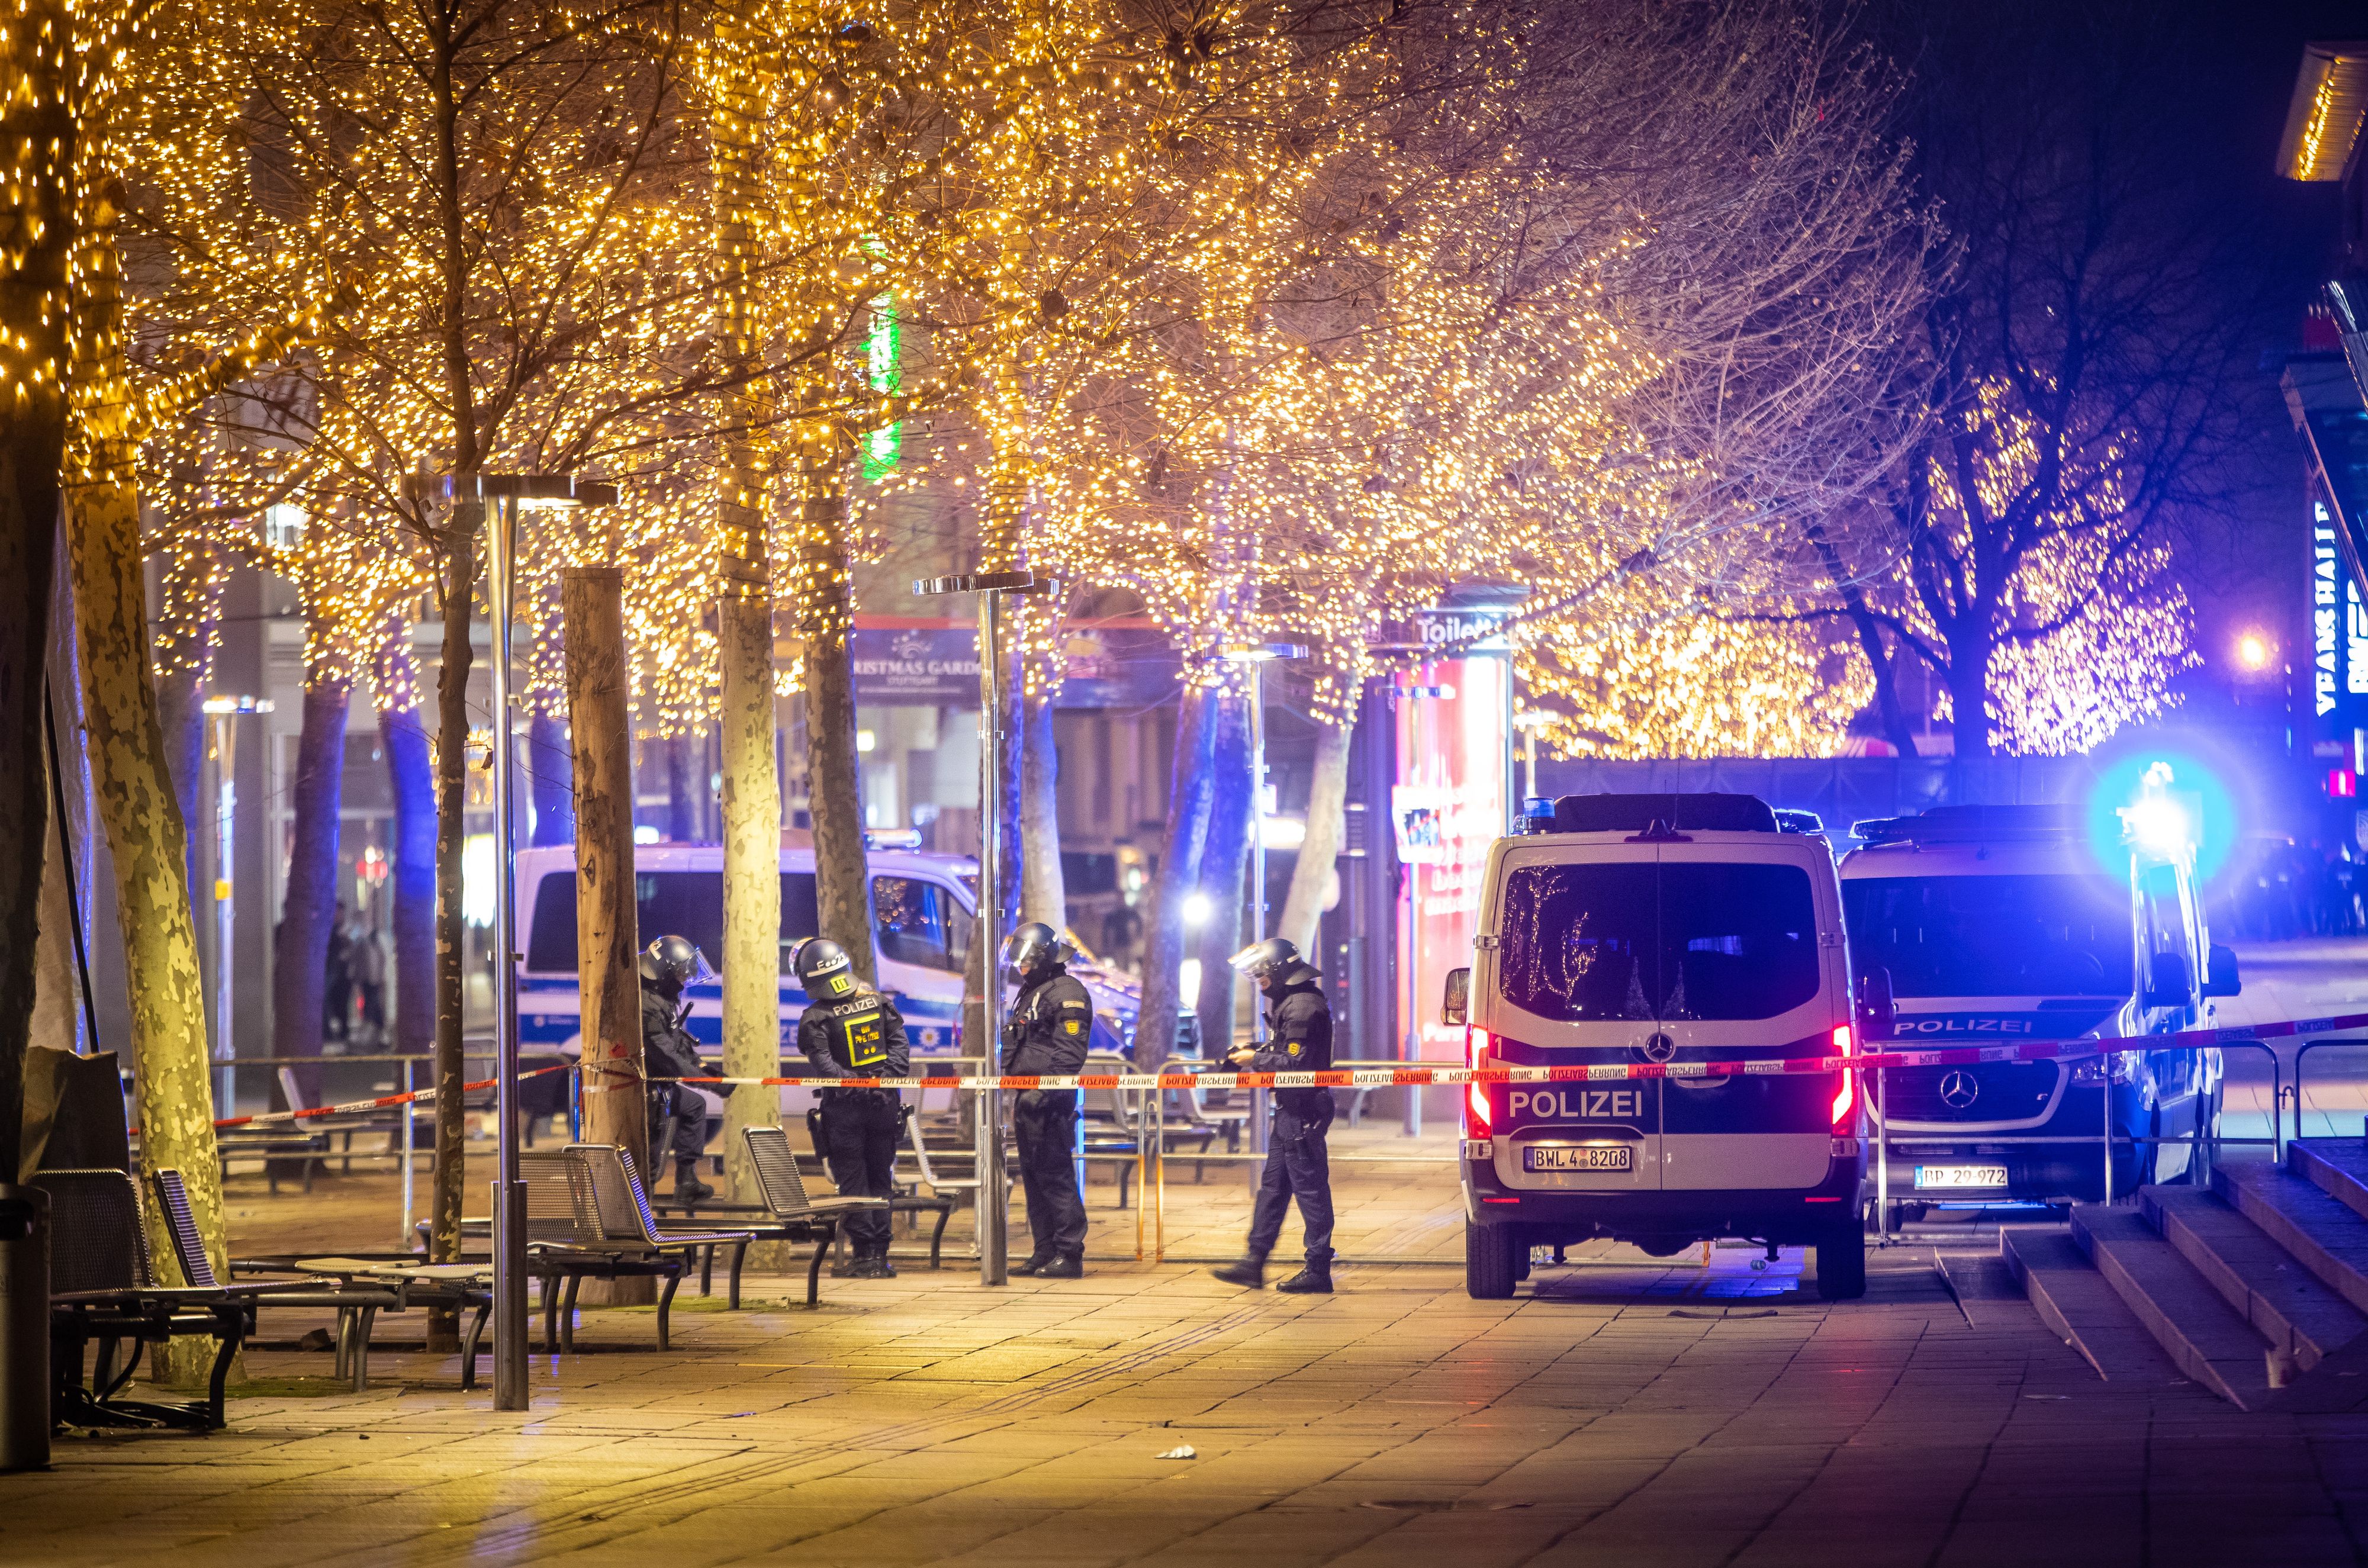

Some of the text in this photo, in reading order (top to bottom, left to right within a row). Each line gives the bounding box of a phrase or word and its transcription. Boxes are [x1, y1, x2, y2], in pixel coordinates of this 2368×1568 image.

[832, 997, 879, 1016] POLIZEI
[1893, 1019, 2032, 1035] POLIZEI
[1495, 1036, 1502, 1059] 1
[1510, 1090, 1642, 1118] POLIZEI
[1536, 1150, 1627, 1167] BWL 4 8208
[1925, 1170, 1944, 1183] BP
